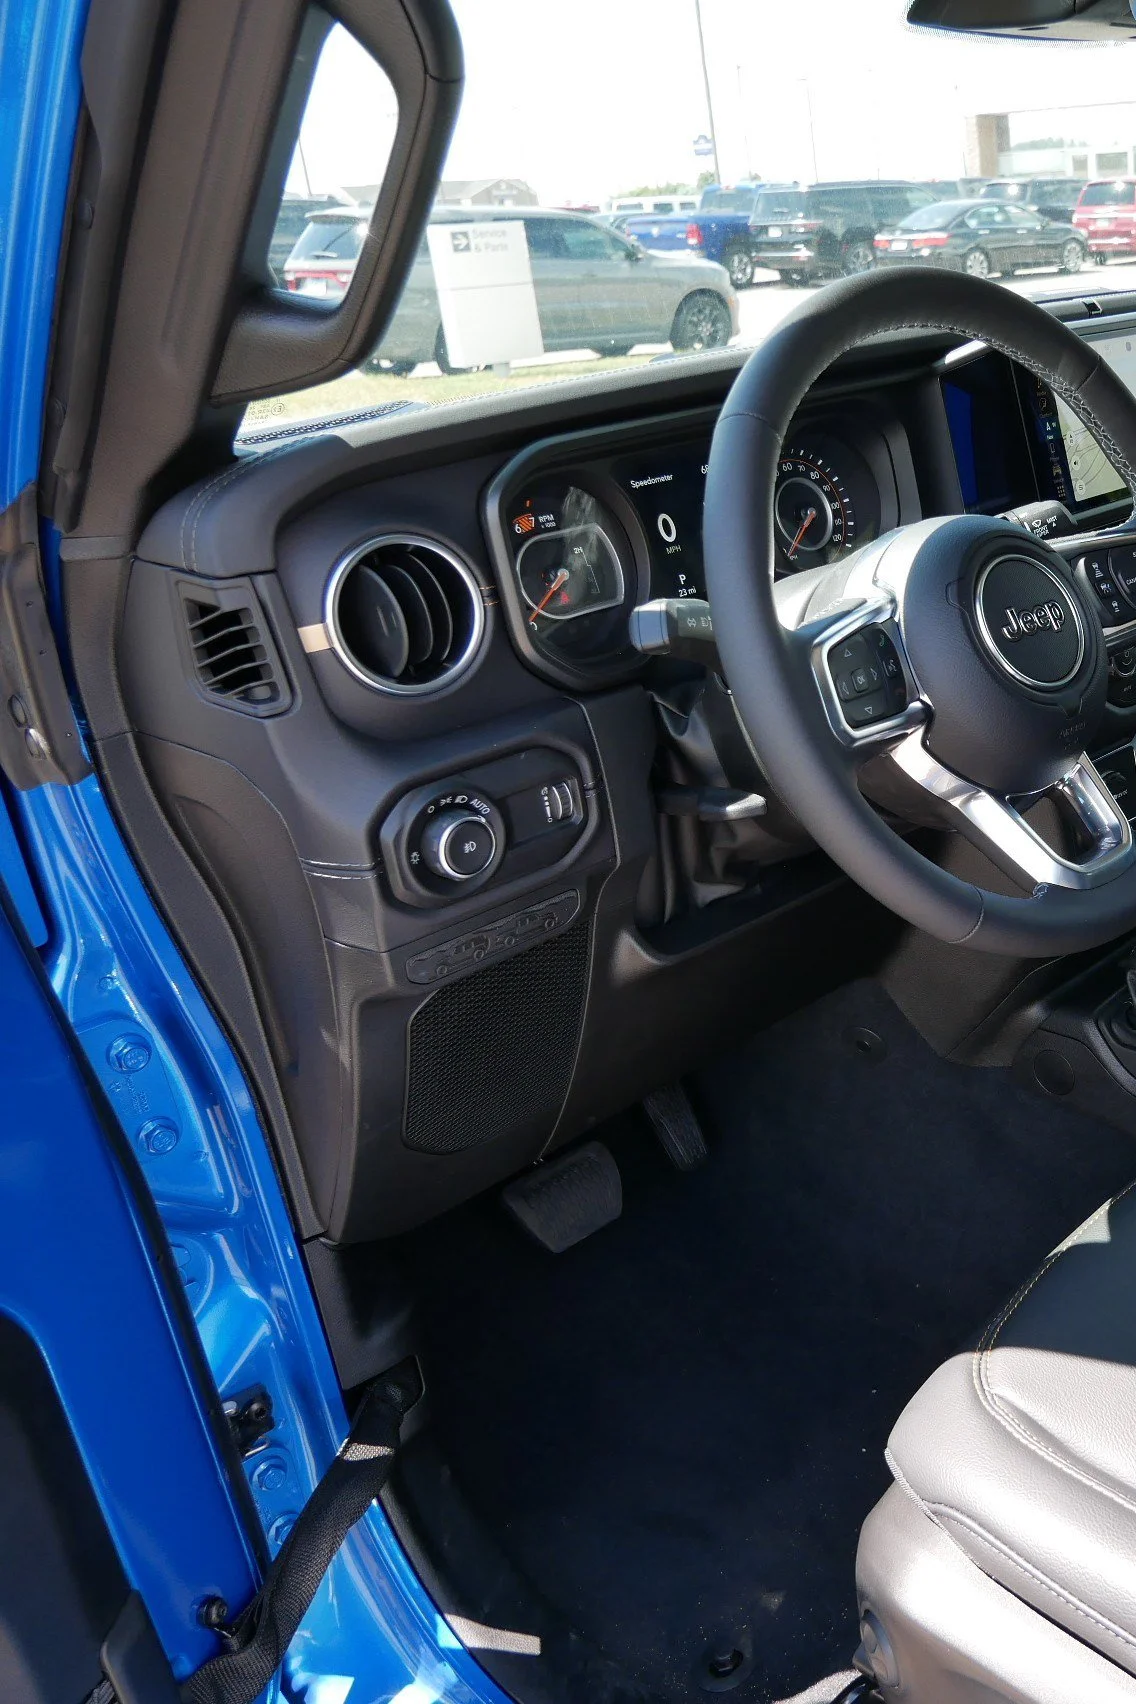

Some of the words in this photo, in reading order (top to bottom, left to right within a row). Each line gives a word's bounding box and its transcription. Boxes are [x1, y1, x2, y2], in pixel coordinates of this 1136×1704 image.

[782, 462, 792, 472] 60
[810, 471, 820, 480] 80
[630, 474, 673, 489] Speedometer
[822, 484, 831, 492] 90
[831, 501, 840, 510] 100
[529, 517, 535, 528] 7
[538, 513, 555, 523] RPM
[515, 524, 522, 534] 6
[657, 513, 677, 542] 0
[665, 545, 682, 555] MPH
[678, 574, 686, 585] P
[679, 588, 688, 597] 23
[688, 586, 697, 595] mi
[1002, 600, 1065, 642] Jeep
[857, 675, 865, 684] OK
[470, 798, 490, 815] AUTO
